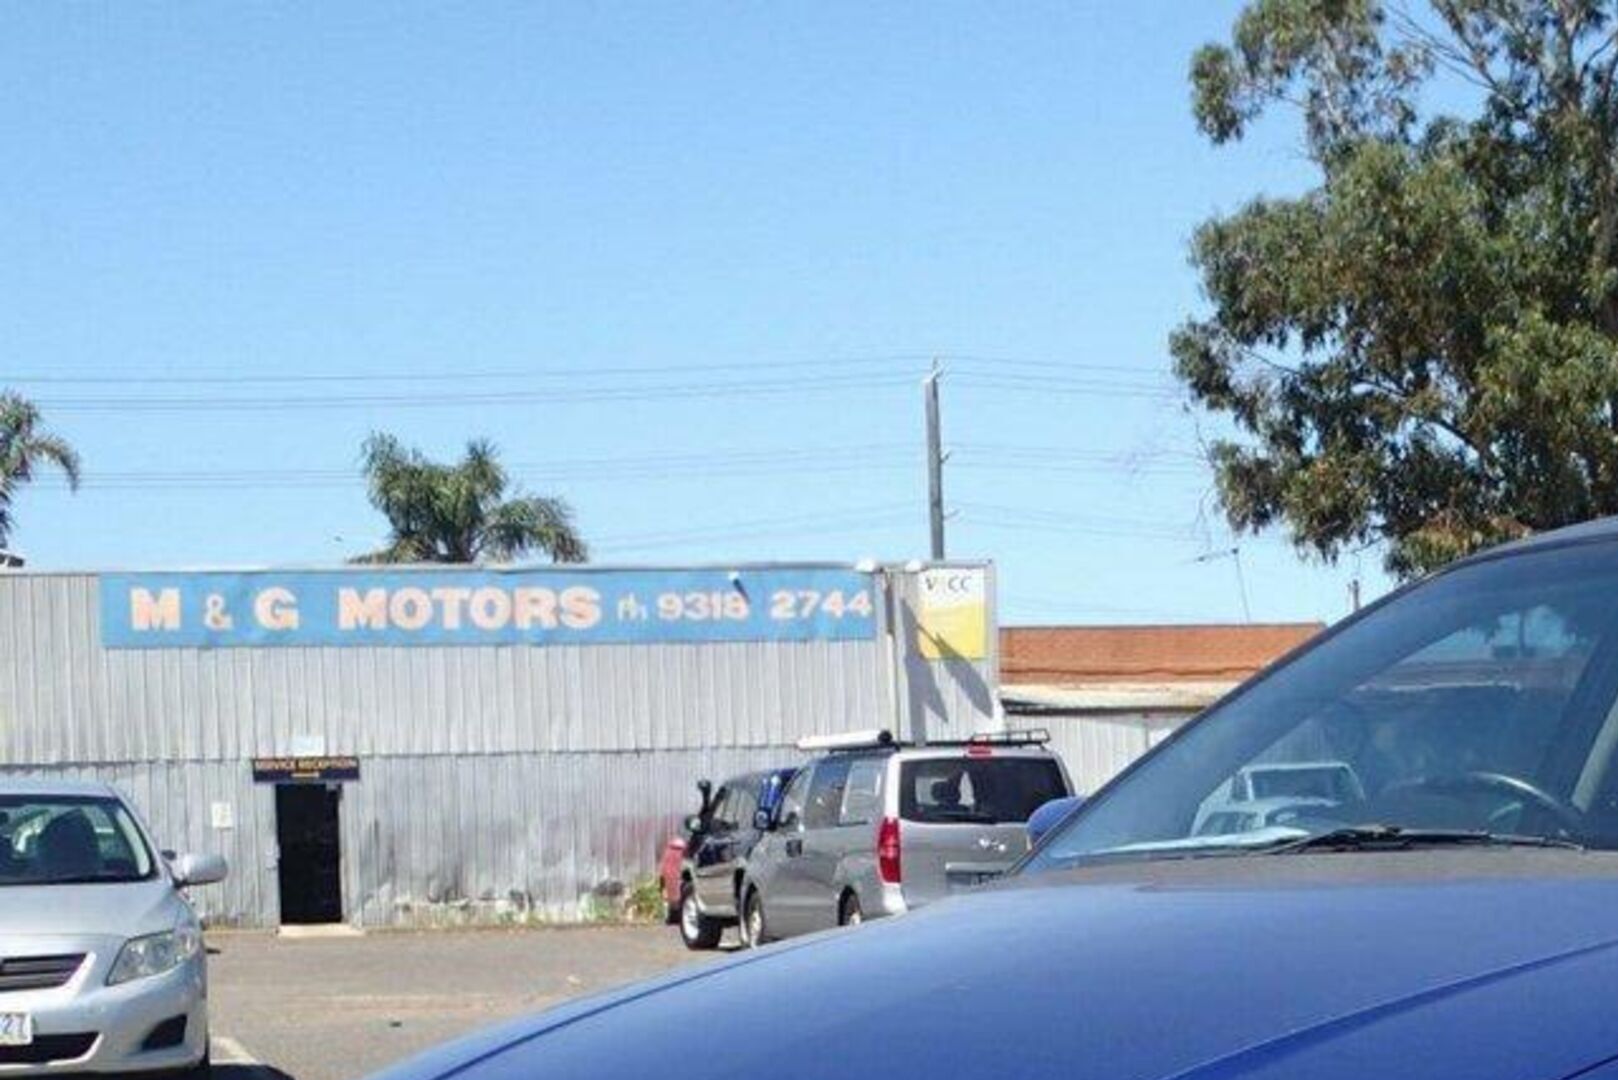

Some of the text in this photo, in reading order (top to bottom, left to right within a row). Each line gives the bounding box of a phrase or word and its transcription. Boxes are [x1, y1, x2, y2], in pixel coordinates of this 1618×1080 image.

[131, 587, 181, 630] M
[204, 594, 233, 629] &
[254, 587, 299, 629] G
[338, 586, 600, 629] MOTORS
[656, 591, 749, 620] 9318
[770, 590, 872, 619] 2744
